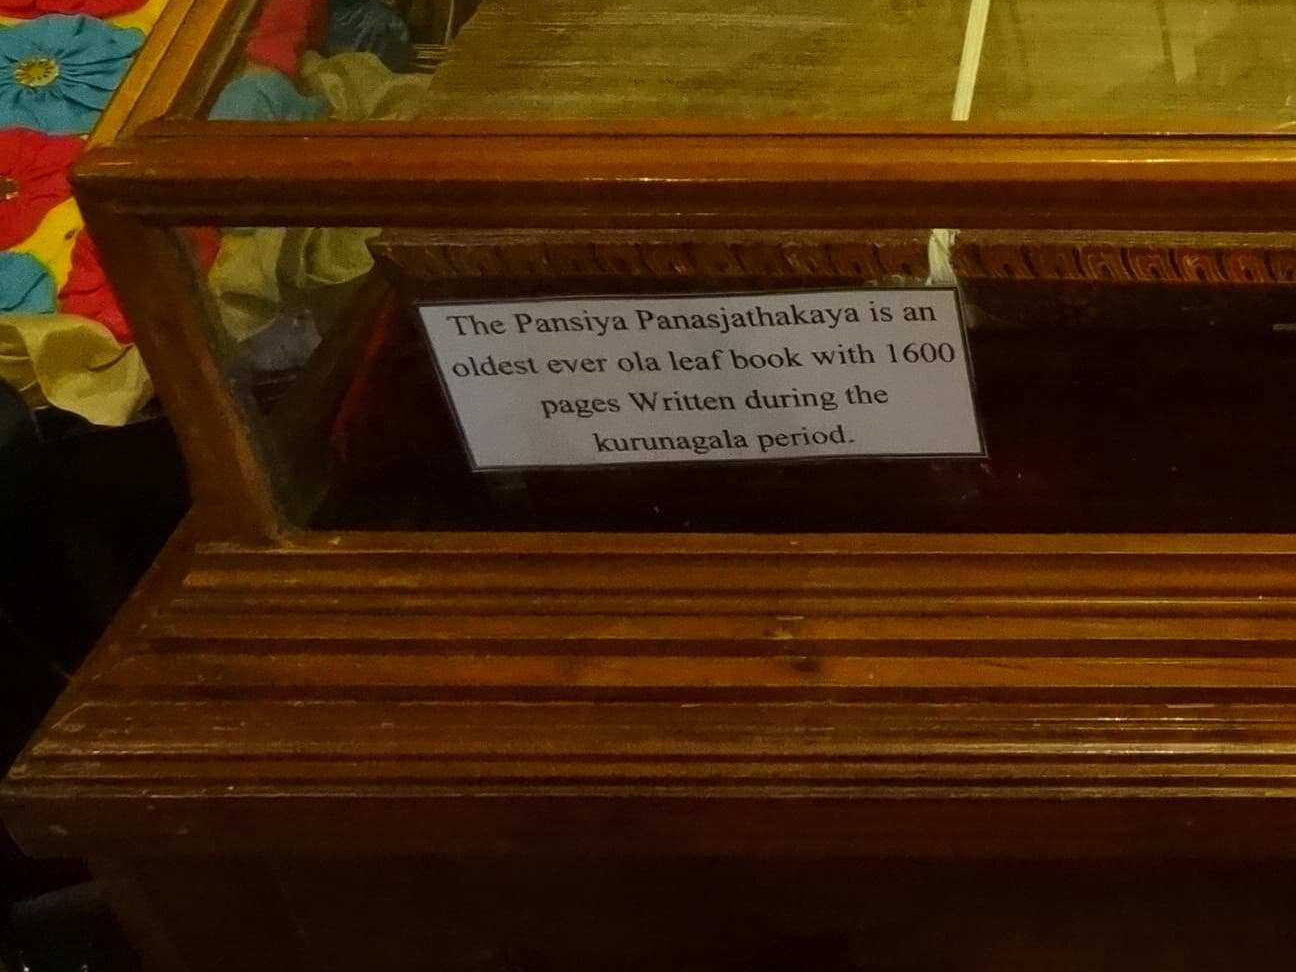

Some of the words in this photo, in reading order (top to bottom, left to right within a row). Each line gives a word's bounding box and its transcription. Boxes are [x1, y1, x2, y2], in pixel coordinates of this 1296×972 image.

[447, 314, 506, 336] The
[514, 311, 629, 336] Pansiya
[637, 304, 860, 334] Panasjathakaya
[869, 301, 893, 322] is
[903, 306, 937, 322] an
[452, 355, 539, 377] oldest
[546, 358, 608, 374] ever
[617, 351, 661, 372] ola
[669, 349, 724, 372] leaf
[729, 347, 804, 369] book
[811, 343, 875, 365] with
[887, 342, 956, 364] 1600
[540, 398, 621, 419] pages
[628, 391, 736, 412] Written
[745, 388, 839, 411] during
[845, 384, 888, 404] the
[592, 429, 749, 455] kurunagala
[757, 424, 855, 451] period.
